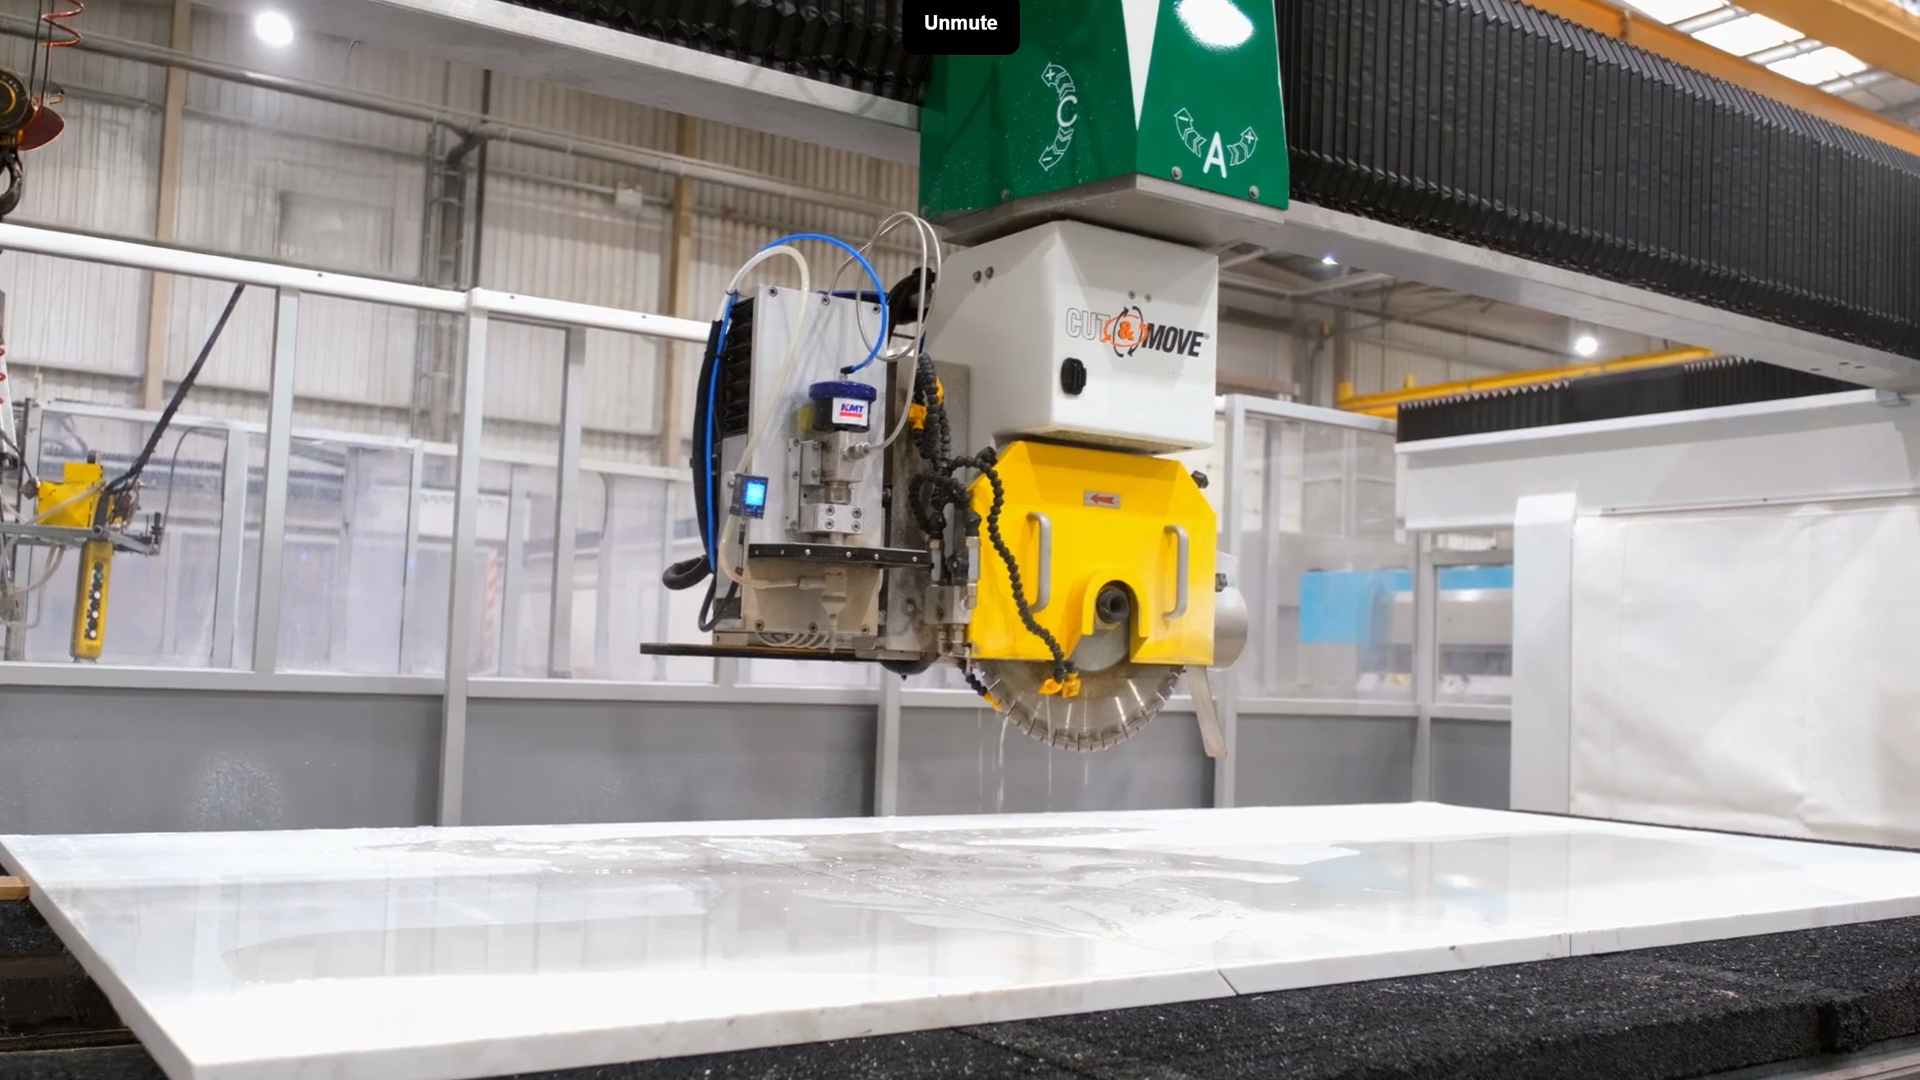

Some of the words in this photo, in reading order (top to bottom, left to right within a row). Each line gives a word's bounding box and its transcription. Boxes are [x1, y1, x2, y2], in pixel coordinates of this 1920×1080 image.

[1057, 95, 1078, 128] C
[1203, 131, 1228, 179] A
[1066, 307, 1111, 343] CUT
[1117, 320, 1135, 341] &
[840, 403, 865, 413] KMT
